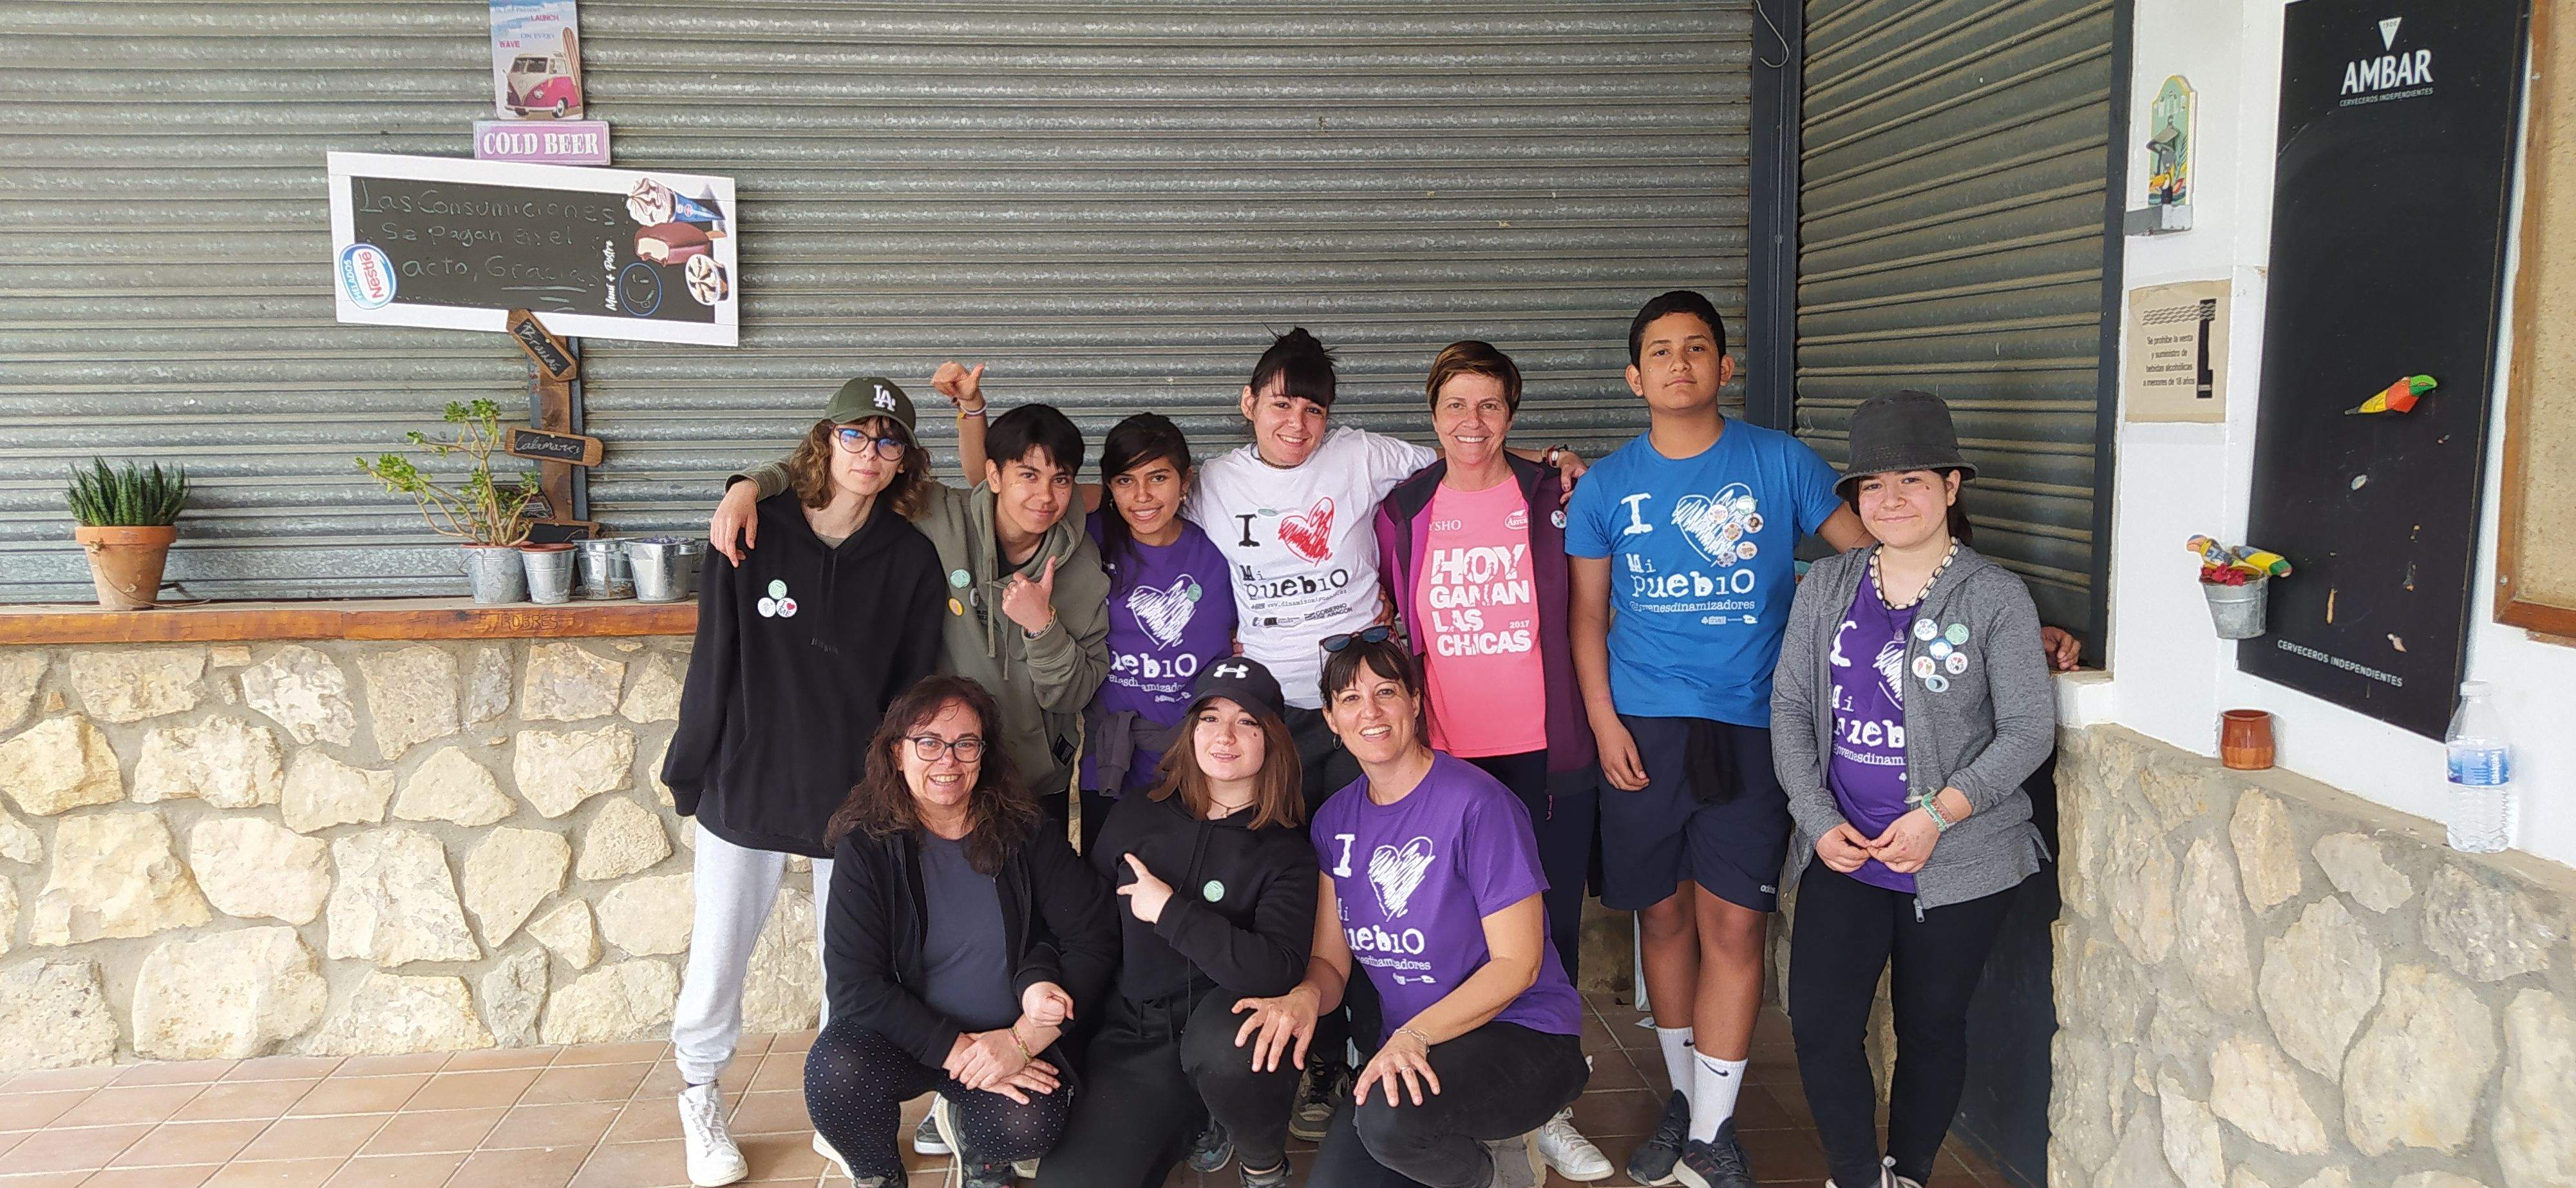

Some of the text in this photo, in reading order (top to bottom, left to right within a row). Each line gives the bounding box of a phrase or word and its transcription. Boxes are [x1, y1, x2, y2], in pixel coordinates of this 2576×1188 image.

[498, 40, 520, 48] WAVE
[2340, 49, 2434, 95] AMBAR
[2339, 87, 2434, 107] CERVECEROS INDEPENDIENTES
[484, 132, 599, 155] COLD BEER
[549, 225, 573, 245] el
[343, 258, 365, 300] HELADOS
[358, 251, 385, 299] Nestlé
[2168, 377, 2175, 386] de
[873, 385, 896, 412] LA
[1620, 493, 1653, 536] I
[1235, 513, 1260, 547] I
[1430, 543, 1526, 584] HOY
[1428, 580, 1530, 609] GANAN
[500, 613, 560, 630] ROBRES
[1431, 609, 1484, 633] LAS
[1509, 620, 1530, 629] 2017
[1436, 629, 1532, 656] CHICAS
[2277, 639, 2403, 687] CERVECEROS INDEPENDIENTES
[1333, 834, 1356, 878] I
